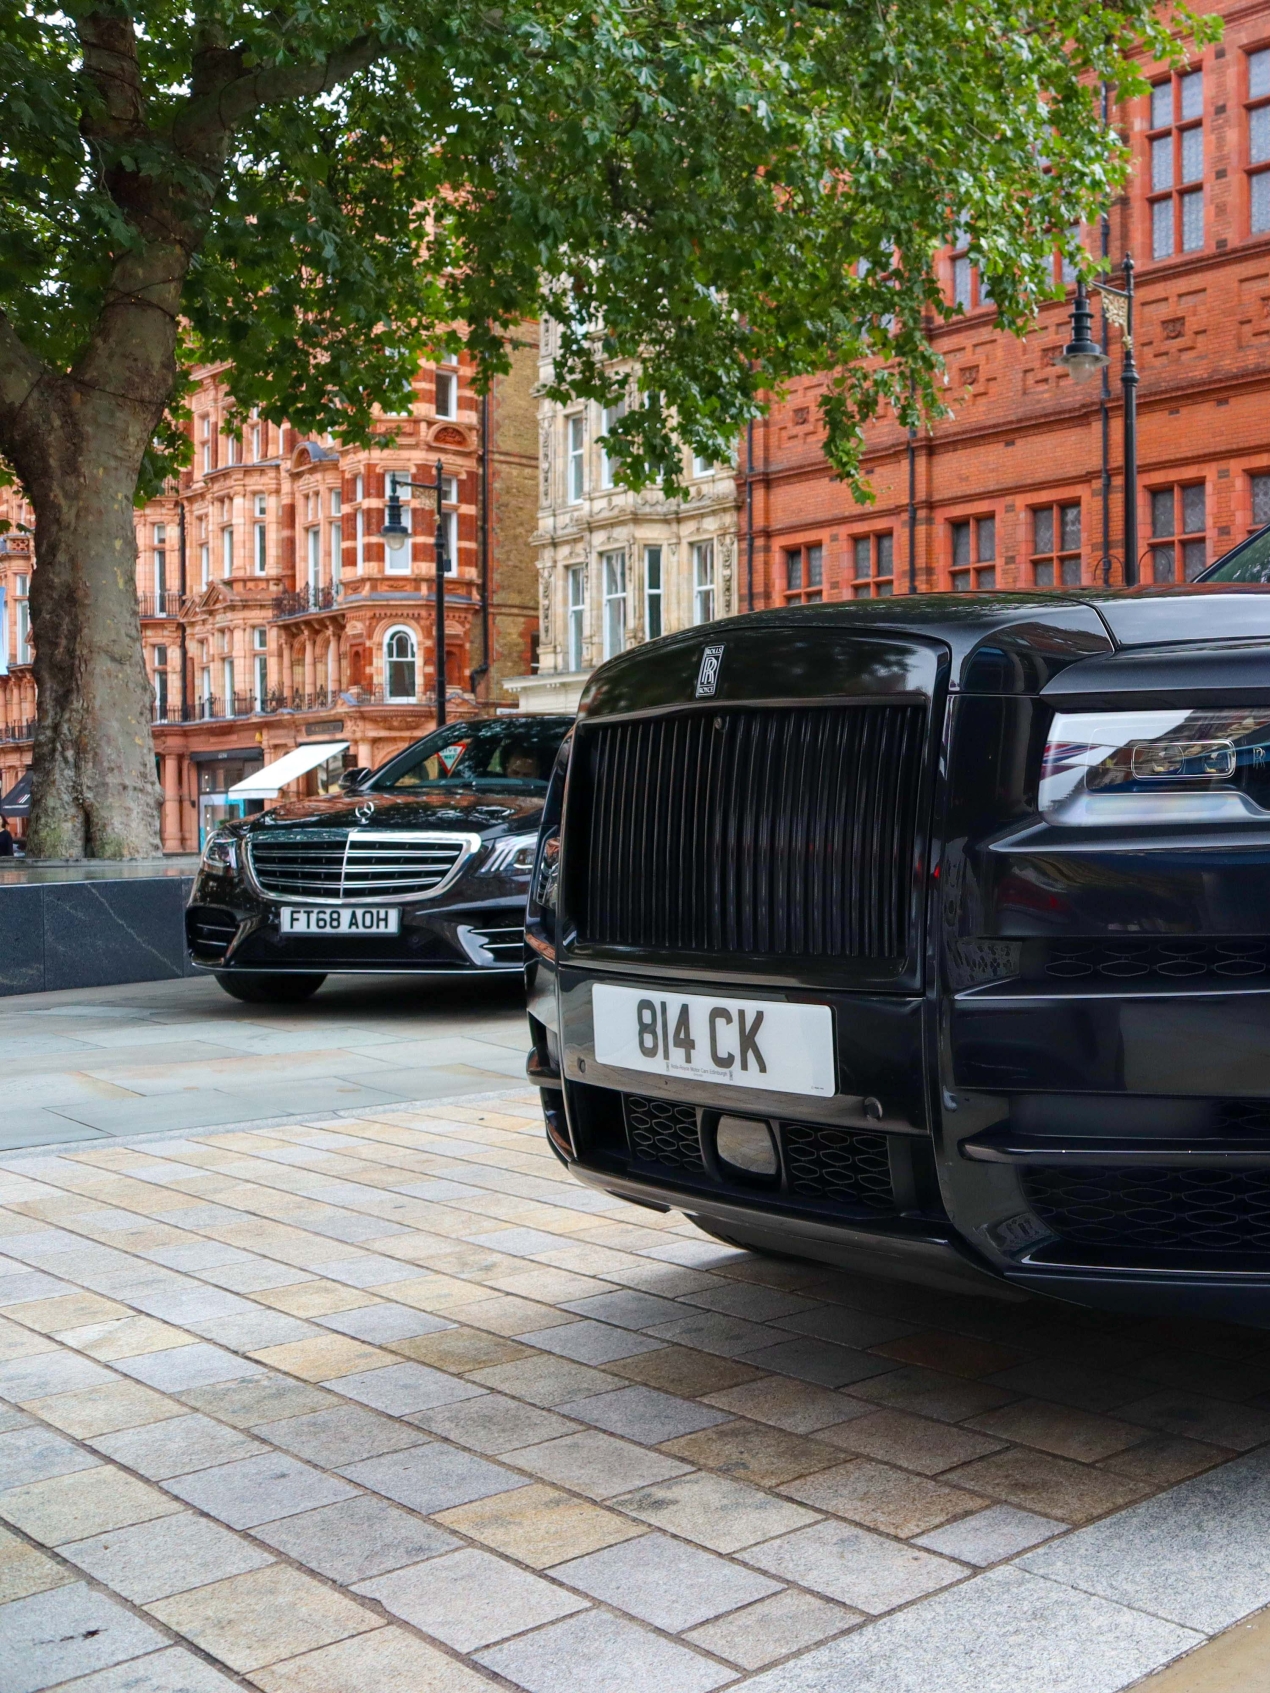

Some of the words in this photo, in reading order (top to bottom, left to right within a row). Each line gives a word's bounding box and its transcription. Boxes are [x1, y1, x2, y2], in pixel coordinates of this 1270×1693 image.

[290, 910, 341, 929] FT68
[348, 910, 389, 929] AOH
[637, 998, 696, 1064] 814
[709, 1006, 767, 1074] CK
